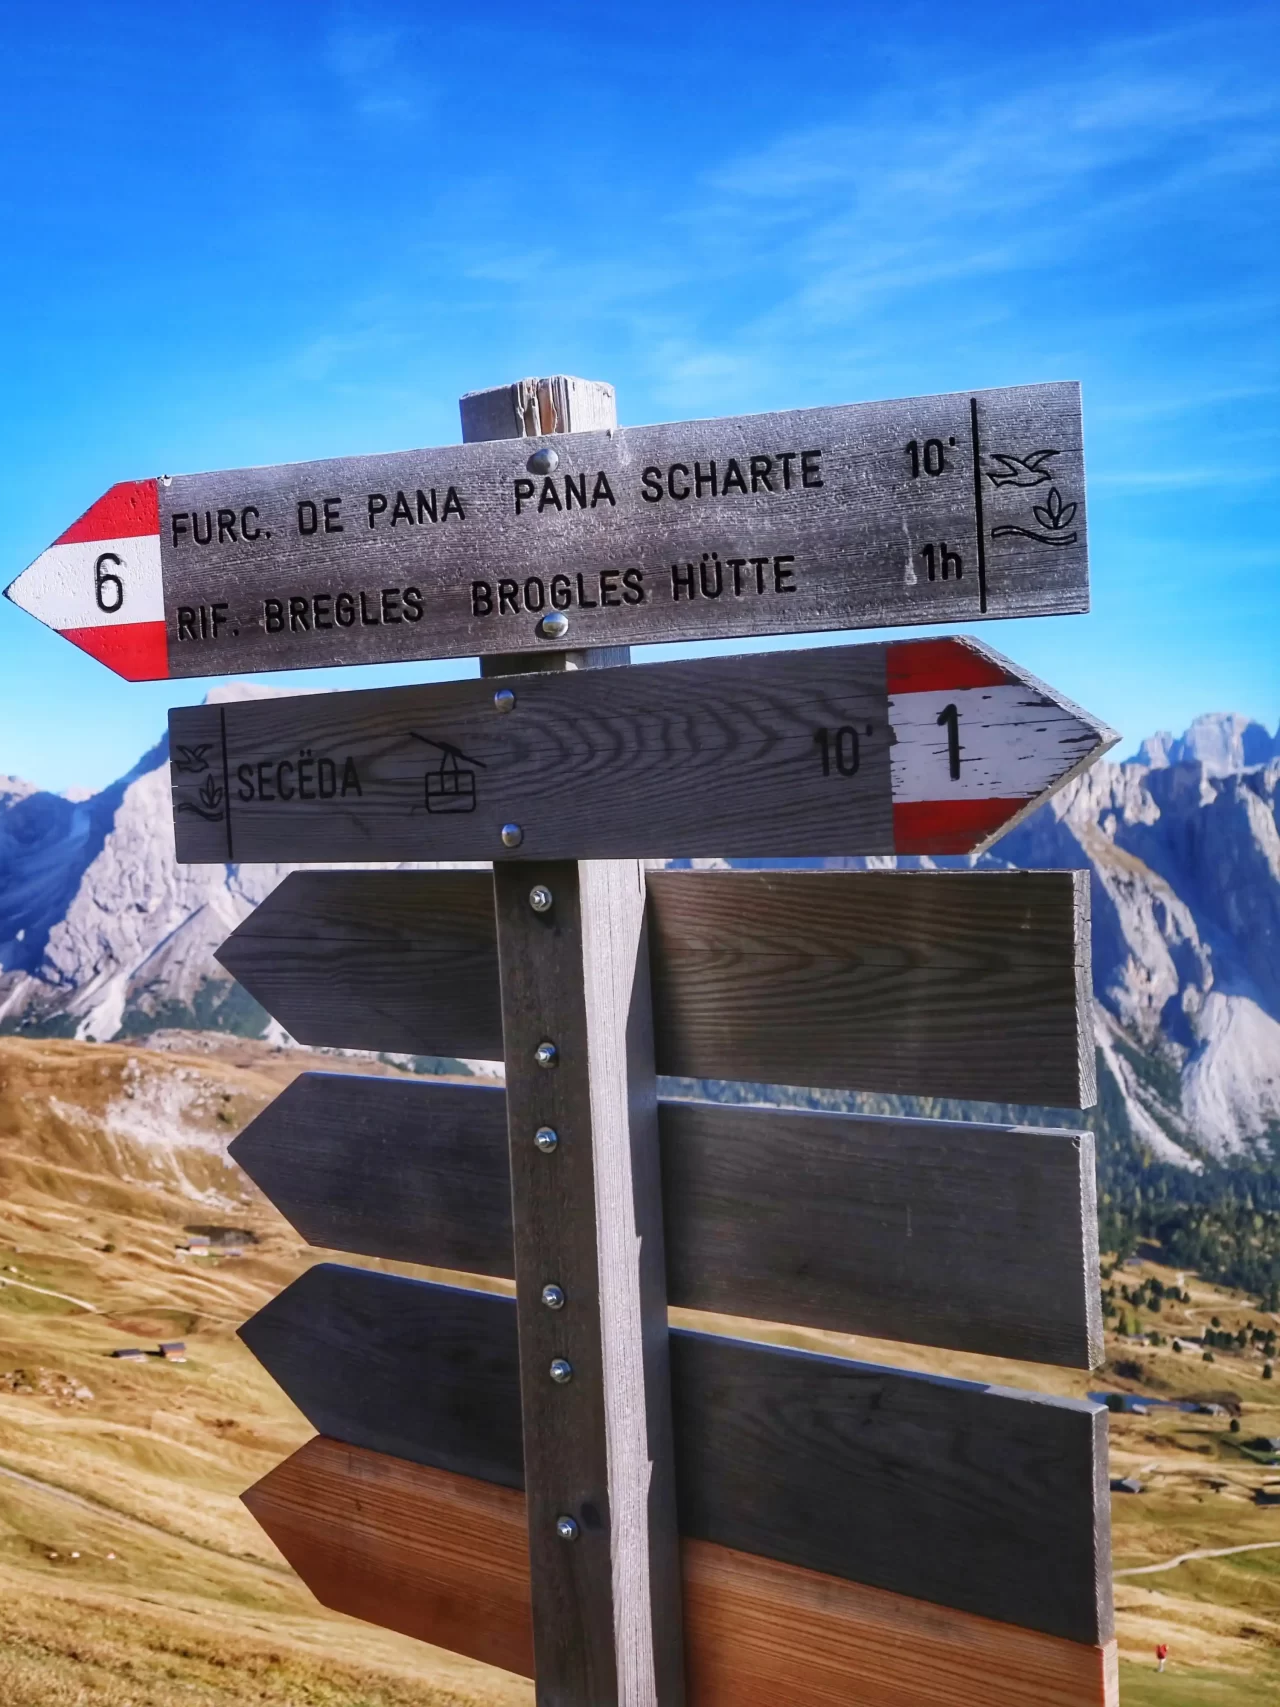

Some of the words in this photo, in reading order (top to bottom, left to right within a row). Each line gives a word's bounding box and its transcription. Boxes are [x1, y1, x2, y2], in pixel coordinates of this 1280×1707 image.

[171, 506, 272, 548] FURC.
[297, 497, 344, 536] DE
[367, 486, 466, 529] PANA
[514, 473, 616, 515] PANA
[640, 450, 824, 502] SCHARTE
[94, 552, 125, 614] 6
[177, 604, 239, 641] RIF.
[264, 587, 424, 634] BREGLES
[471, 567, 644, 617] BROGLES
[671, 553, 797, 600] HÜTTE
[922, 543, 963, 582] 1h
[237, 750, 363, 801] SECËDA
[936, 703, 961, 780] 1
